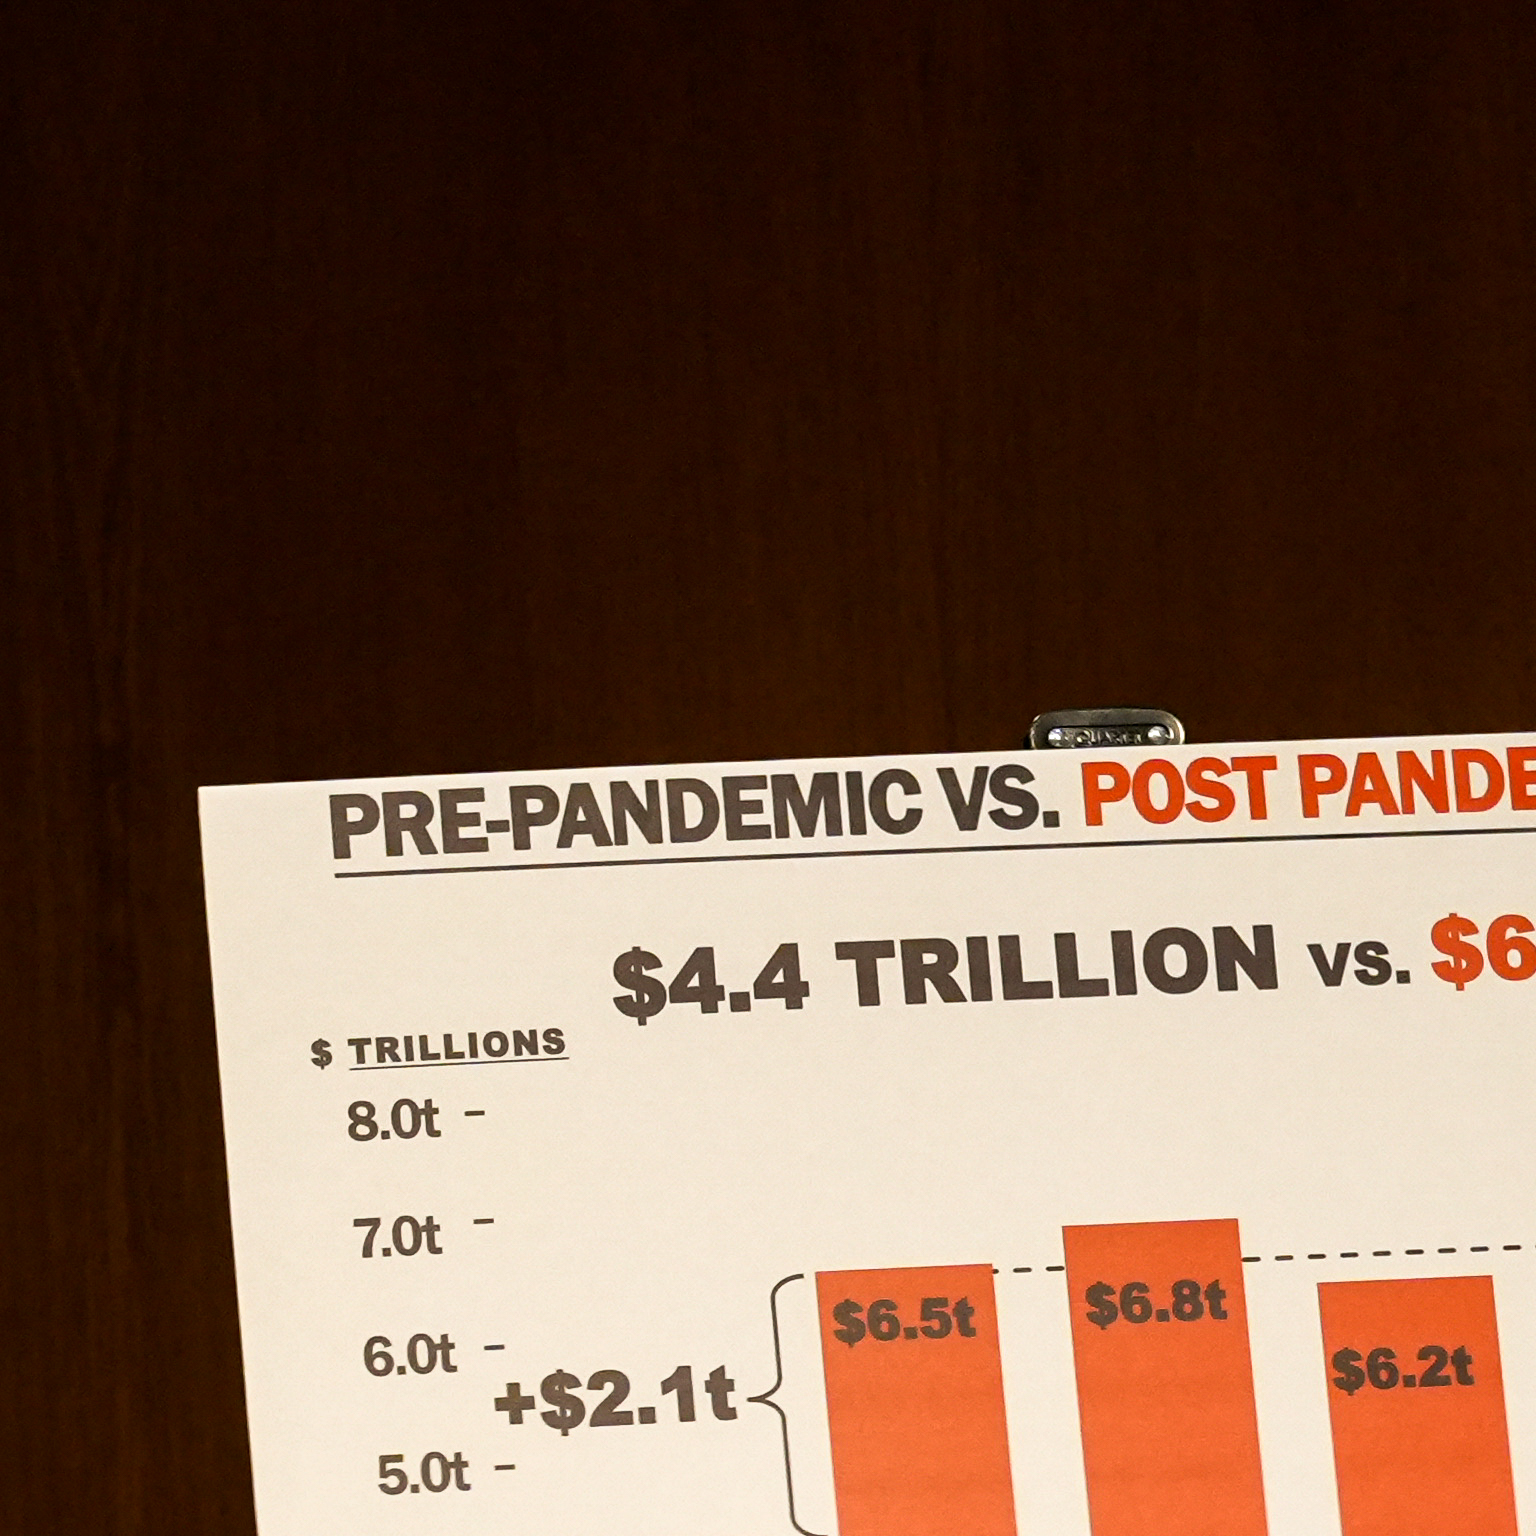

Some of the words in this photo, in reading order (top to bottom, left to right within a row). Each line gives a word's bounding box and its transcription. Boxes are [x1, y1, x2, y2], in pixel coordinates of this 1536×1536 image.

[327, 769, 924, 860] PRE-PANDEMIC
[936, 764, 1061, 832] VS.
[1080, 756, 1278, 828] POST
[614, 944, 810, 1027] $4.4
[836, 926, 1279, 1007] TRILLION
[1308, 942, 1411, 987] vs.
[312, 1040, 333, 1070] $
[349, 1029, 569, 1062] TRILLIONS
[349, 1100, 442, 1142] 8.0t
[355, 1217, 443, 1259] 7.0t
[835, 1299, 977, 1347] $6.5t
[1087, 1281, 1228, 1330] $6.8t
[365, 1335, 458, 1377] 6.0t
[1333, 1345, 1475, 1396] $6.2t
[496, 1367, 738, 1437] +$2.1t
[380, 1453, 471, 1496] 5.0t
